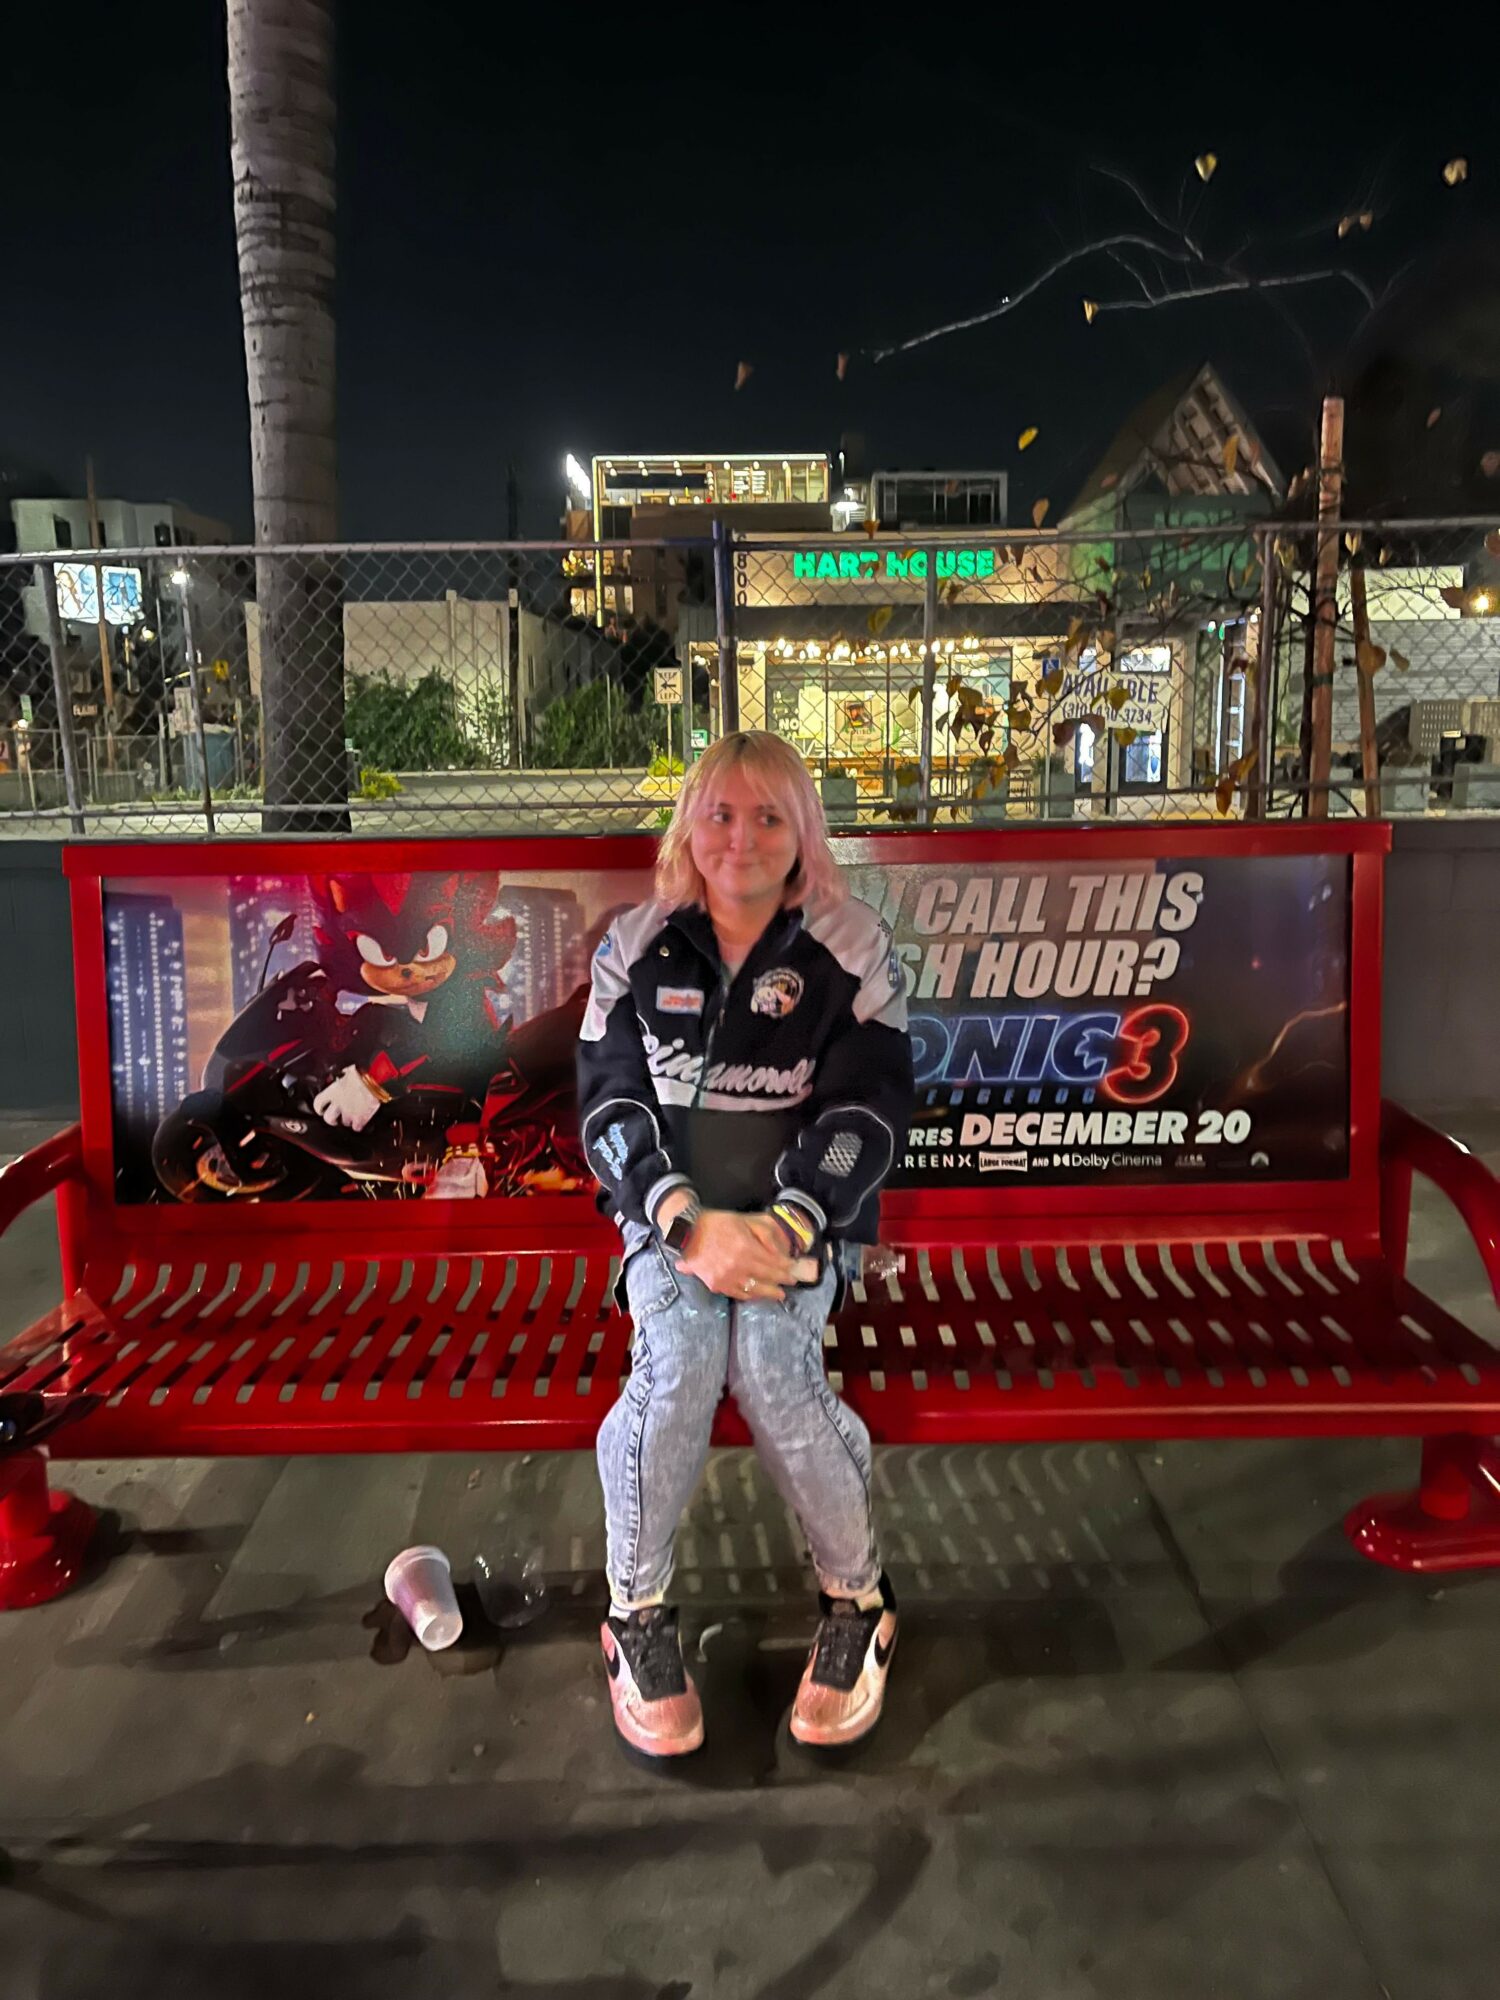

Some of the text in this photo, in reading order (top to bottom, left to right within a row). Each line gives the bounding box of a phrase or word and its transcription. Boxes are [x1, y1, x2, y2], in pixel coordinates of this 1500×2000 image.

[886, 550, 995, 578] HOUSE
[660, 692, 676, 700] LEFT
[1062, 674, 1160, 704] AVAILBLE
[912, 877, 1049, 936] CALL
[1066, 872, 1204, 932] THIS
[970, 937, 1181, 998] HOUR?
[1104, 1003, 1190, 1105] 3
[907, 1110, 1252, 1147] RES DECEMBER 20
[1032, 1157, 1049, 1168] AND
[1072, 1152, 1110, 1170] Dolby
[1112, 1152, 1162, 1167] Cinema
